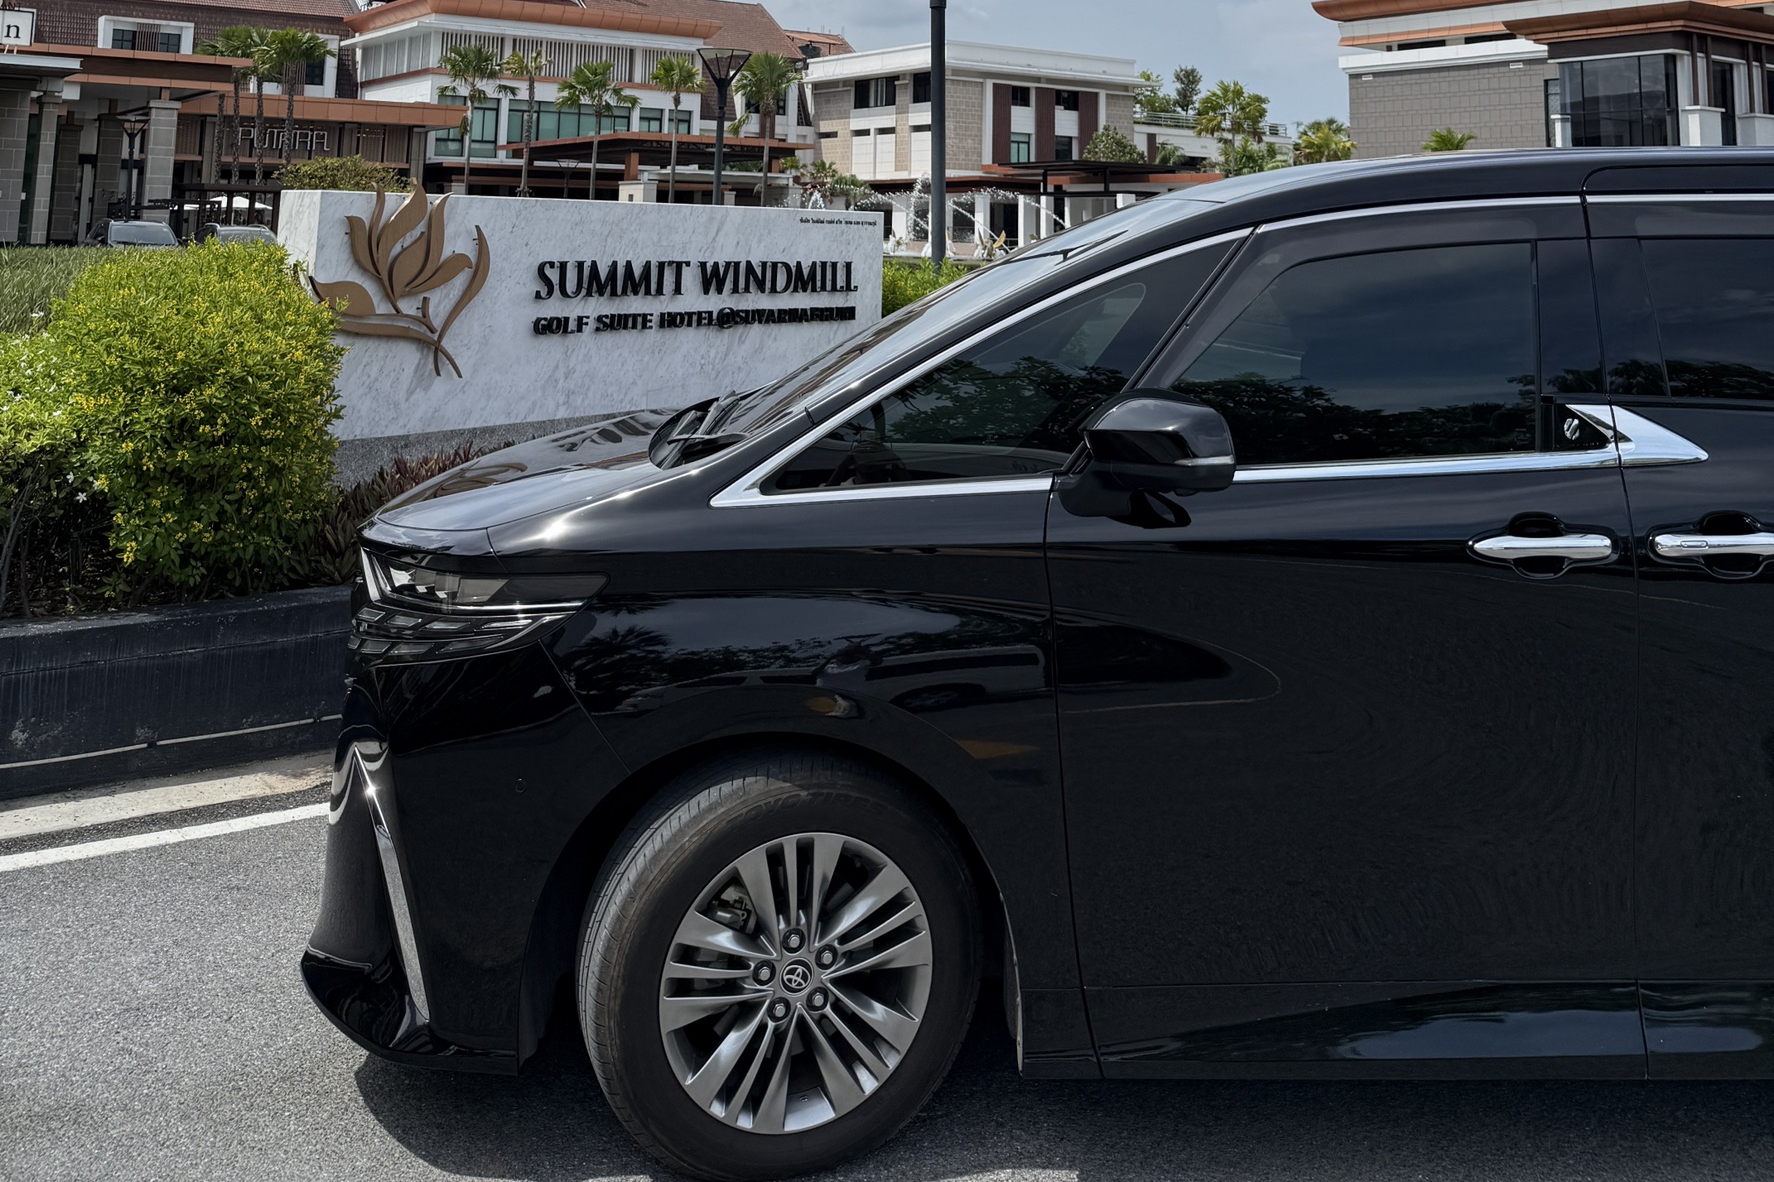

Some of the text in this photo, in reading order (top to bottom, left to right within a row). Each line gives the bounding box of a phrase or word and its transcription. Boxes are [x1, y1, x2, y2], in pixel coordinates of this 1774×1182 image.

[534, 259, 859, 300] SUMMIT WINDMILL
[533, 315, 590, 335] GOLF
[595, 313, 654, 332] SUITE
